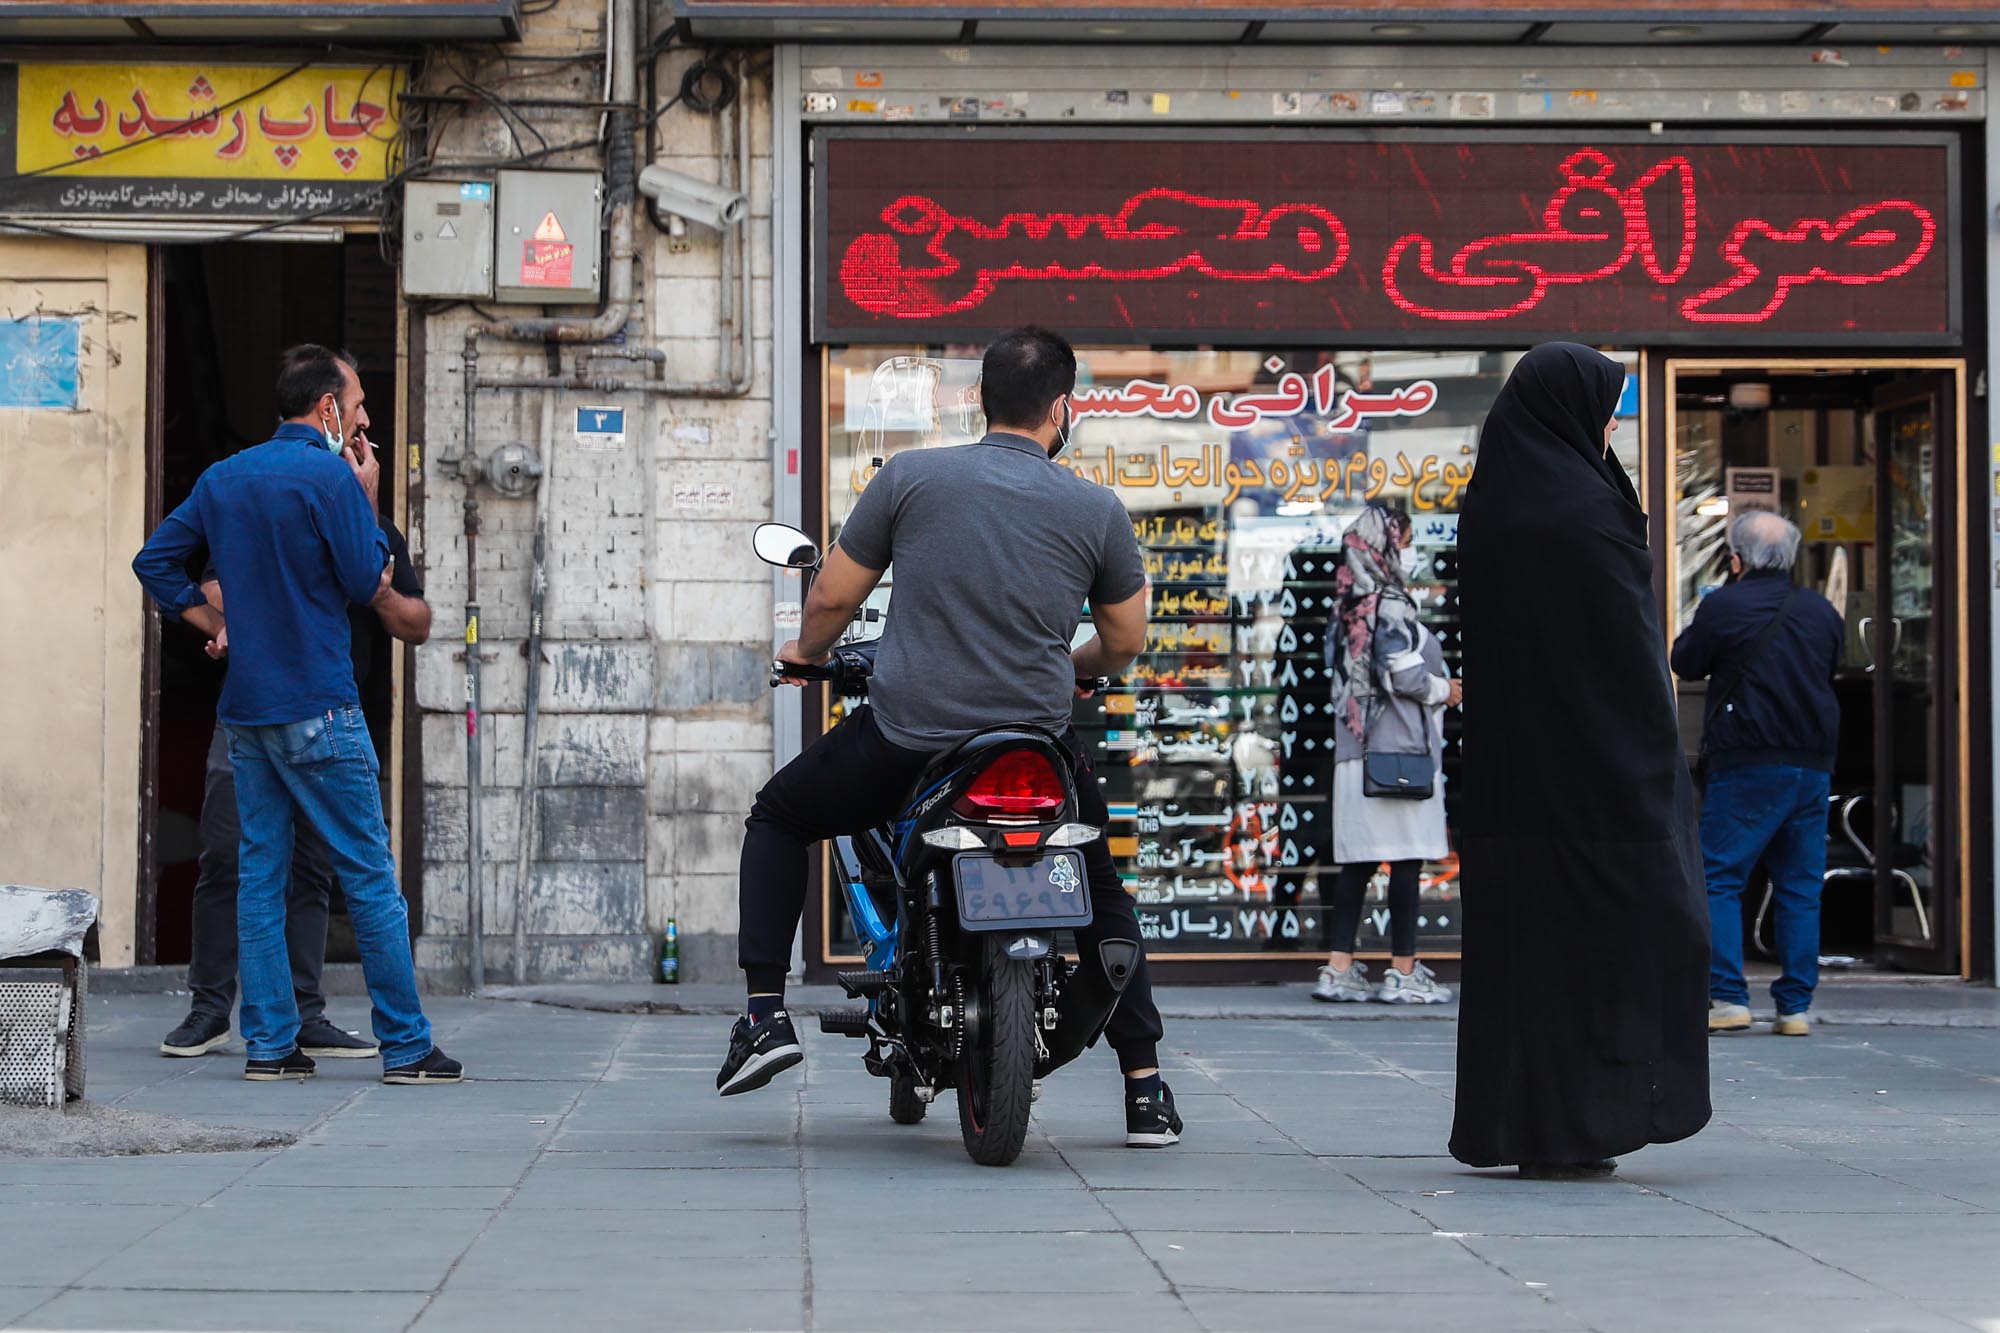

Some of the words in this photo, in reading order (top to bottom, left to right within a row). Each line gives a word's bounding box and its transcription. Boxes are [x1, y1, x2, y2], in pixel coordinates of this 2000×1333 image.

[52, 74, 249, 160] رشدیه
[258, 82, 387, 172] چاپ
[212, 184, 262, 208] صحافی
[267, 185, 333, 211] لیتوگرافی
[1382, 147, 1936, 323] صرافی
[1070, 379, 1200, 427] محس
[1207, 355, 1438, 432] صرافی
[594, 412, 607, 430] ۳
[1119, 444, 1265, 507] حوالجات
[1345, 451, 1414, 500] دوم
[1413, 446, 1475, 510] نوع
[1159, 874, 1235, 904] دینار
[1161, 909, 1233, 939] ریال
[1239, 909, 1317, 938] ۷۷۵۰
